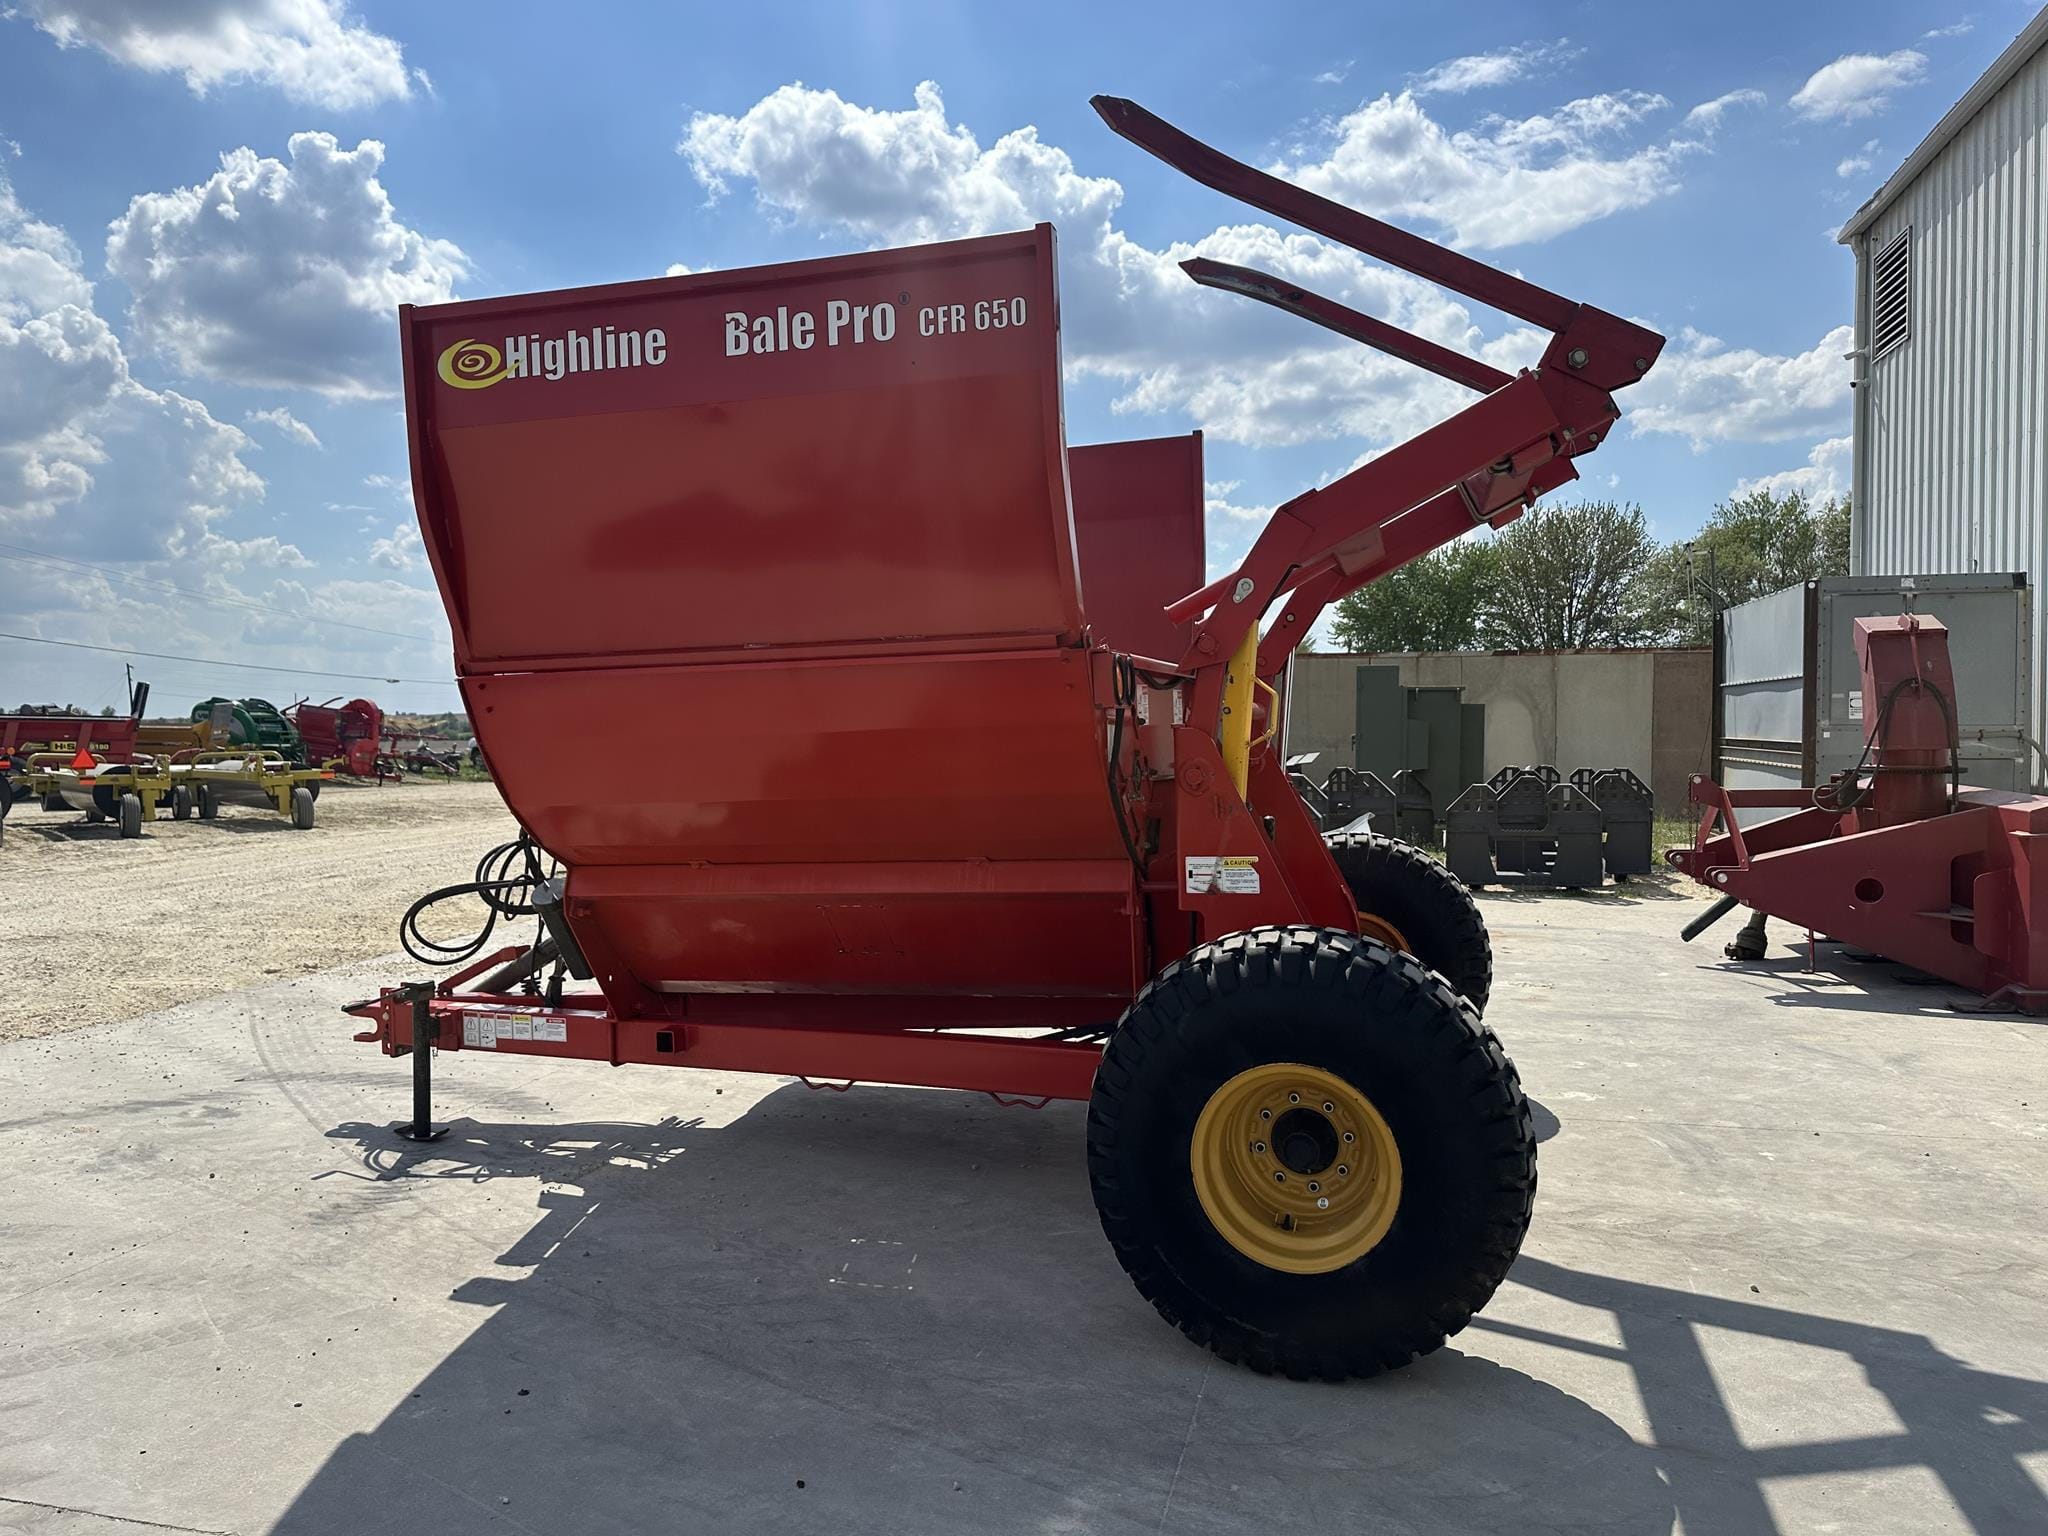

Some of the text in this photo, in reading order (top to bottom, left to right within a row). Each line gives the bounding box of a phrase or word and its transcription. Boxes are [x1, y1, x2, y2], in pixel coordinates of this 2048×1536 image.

[504, 325, 667, 382] Highline
[725, 296, 1027, 357] Bale Pro CFR 650
